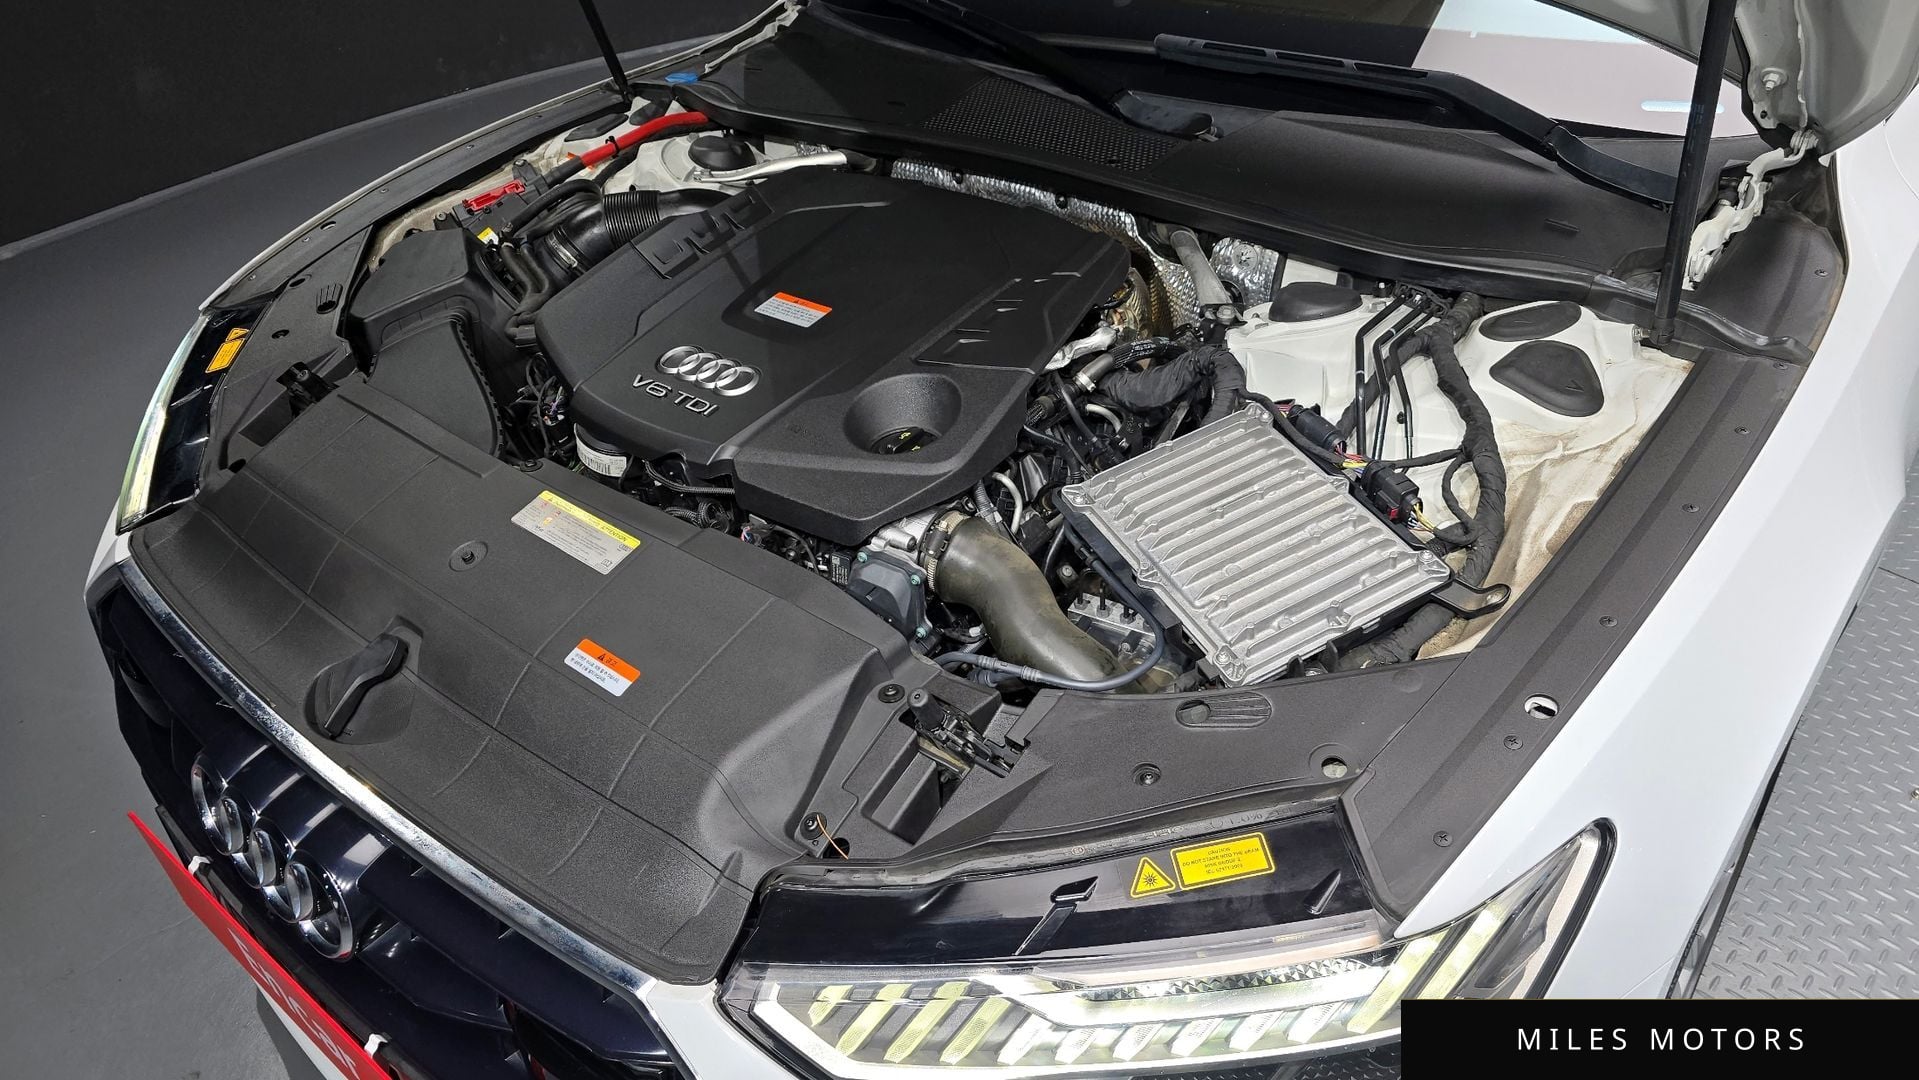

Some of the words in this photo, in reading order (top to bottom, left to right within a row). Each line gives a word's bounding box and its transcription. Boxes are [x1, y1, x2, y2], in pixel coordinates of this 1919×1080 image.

[632, 374, 672, 397] V6
[674, 390, 718, 415] TDI
[601, 525, 627, 542] ATTENTION
